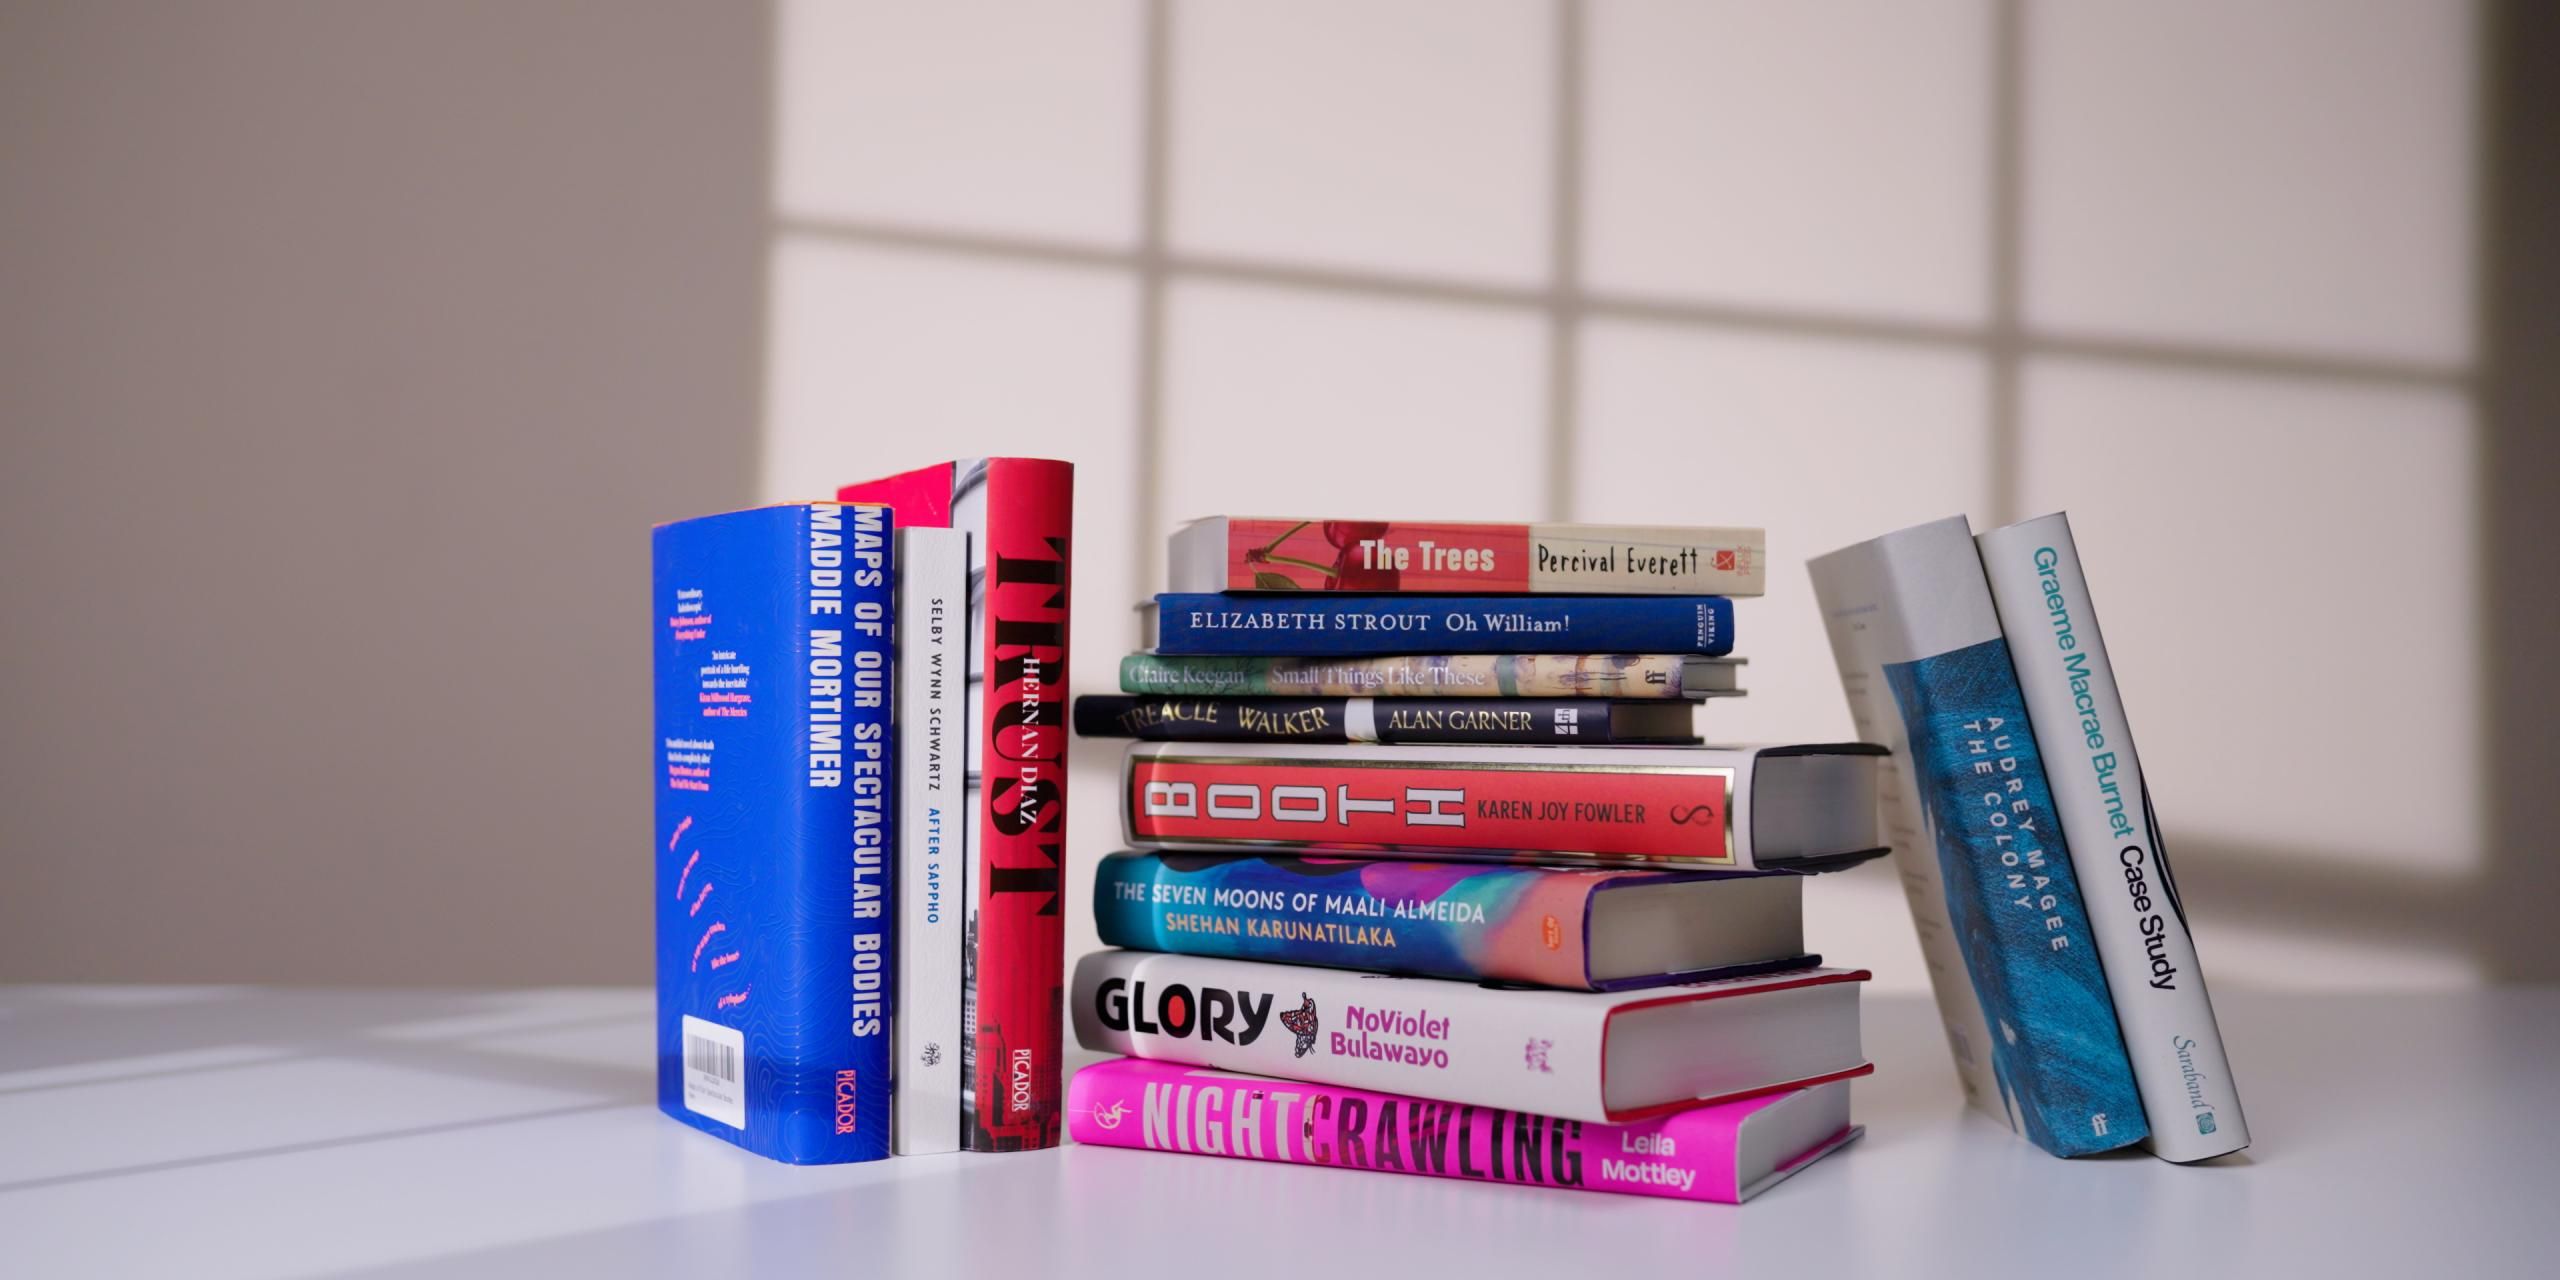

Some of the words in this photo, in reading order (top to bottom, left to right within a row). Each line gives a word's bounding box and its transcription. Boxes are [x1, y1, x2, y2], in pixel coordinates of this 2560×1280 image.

[810, 504, 843, 615] MADDIE
[854, 505, 884, 587] MAPS
[1359, 539, 1409, 571] The
[1418, 541, 1495, 572] Trees
[1538, 544, 1615, 573] Percival
[1627, 547, 1699, 576] Everett
[854, 602, 883, 637] OF
[930, 598, 943, 645] SELBY
[1190, 611, 1325, 630] ELIZABETH
[1334, 613, 1431, 631] STROUT
[1445, 613, 1479, 632] Oh
[1482, 613, 1570, 633] William!
[1696, 603, 1704, 648] PENGUIN
[854, 651, 883, 708] OUR
[929, 653, 942, 700] WYNN
[1128, 664, 1180, 684] Claire
[1183, 665, 1245, 688] Keegan
[1271, 666, 1319, 685] Small
[1322, 666, 1384, 689] Things
[1388, 667, 1426, 685] Like
[1428, 667, 1486, 685] These
[809, 630, 843, 789] MORTIMER
[989, 536, 1066, 916] TRUST
[1021, 658, 1040, 759] HERNAN
[1118, 702, 1218, 733] TREACLE
[1238, 705, 1330, 735] WALKER
[1388, 710, 1443, 730] ALAN
[1448, 710, 1533, 731] GARNER
[928, 707, 942, 791] SCHWARTZ
[2034, 546, 2076, 651] Graeme
[2063, 652, 2105, 750] Macrae
[2092, 751, 2134, 839] Burnet
[2119, 845, 2152, 912] Case
[2139, 914, 2176, 990] Study
[852, 722, 883, 919] SPECTACULAR
[1020, 767, 1038, 824] DIAZ
[1144, 781, 1466, 829] BOOTH
[1477, 800, 1533, 821] KAREN
[1537, 802, 1570, 821] JOY
[1574, 803, 1646, 824] FOWLER
[1963, 720, 1993, 775] THE
[1984, 792, 2033, 910] COLONY
[927, 808, 941, 855] AFTER
[1987, 717, 2036, 833] AUDREY
[2026, 849, 2070, 953] MAGEE
[927, 863, 940, 924] SAPPHO
[1115, 881, 1146, 901] THE
[1152, 884, 1207, 906] SEVEN
[1213, 888, 1284, 911] MOONS
[1291, 892, 1318, 913] OF
[1325, 894, 1385, 917] MAALI
[1393, 898, 1485, 924] ALMEIDA
[1165, 912, 1240, 936] SHEHAN
[1246, 918, 1397, 948] KARUNATILAKA
[851, 933, 882, 1038] BODIES
[1095, 977, 1275, 1047] GLORY
[1346, 1005, 1450, 1041] NoViolet
[1330, 1031, 1449, 1070] Bulawayo
[2173, 1035, 2215, 1110] Saraband
[837, 1069, 855, 1136] PICADOR
[1012, 1049, 1032, 1112] PICADOR
[1142, 1082, 1586, 1188] NIGHTCRAWLING
[1622, 1131, 1675, 1157] Leila
[1602, 1159, 1696, 1192] Mottley
